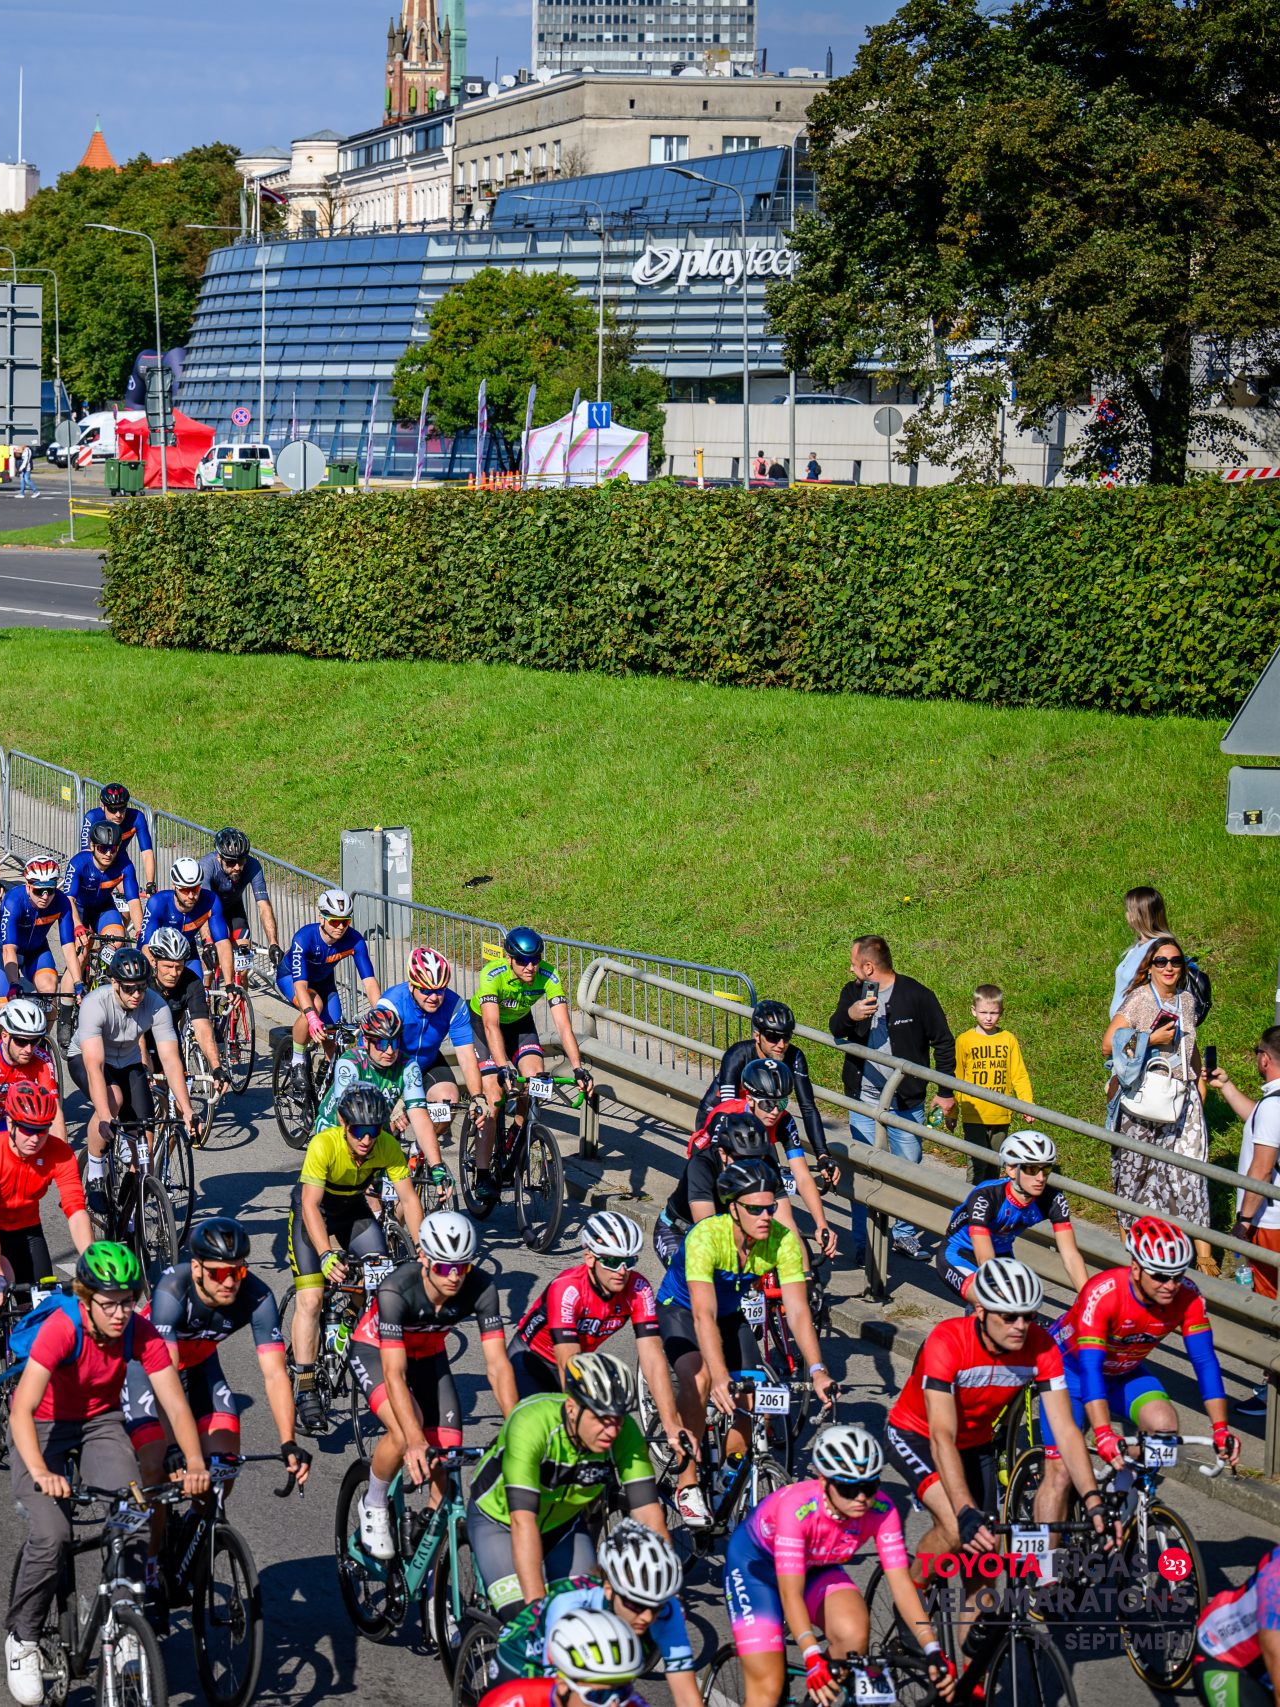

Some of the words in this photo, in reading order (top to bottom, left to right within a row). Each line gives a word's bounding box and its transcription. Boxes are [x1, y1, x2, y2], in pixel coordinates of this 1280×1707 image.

[81, 817, 93, 847] Atom
[64, 863, 76, 894] Atom
[0, 905, 11, 942] Atom
[140, 906, 152, 942] Atom
[292, 941, 304, 979] Atom
[971, 1044, 1009, 1061] RULES
[971, 1060, 987, 1070] ARE
[989, 1059, 1007, 1069] MADE
[530, 1084, 550, 1094] 2014
[971, 1070, 988, 1086] TO
[993, 1069, 1007, 1085] BE
[971, 1194, 989, 1221] RRS
[945, 1267, 964, 1290] RRS
[349, 1356, 373, 1393] ZZK
[759, 1394, 785, 1407] 2061
[886, 1424, 932, 1475] SCOTT
[1016, 1539, 1046, 1554] 2118
[730, 1567, 756, 1627] VALCAR
